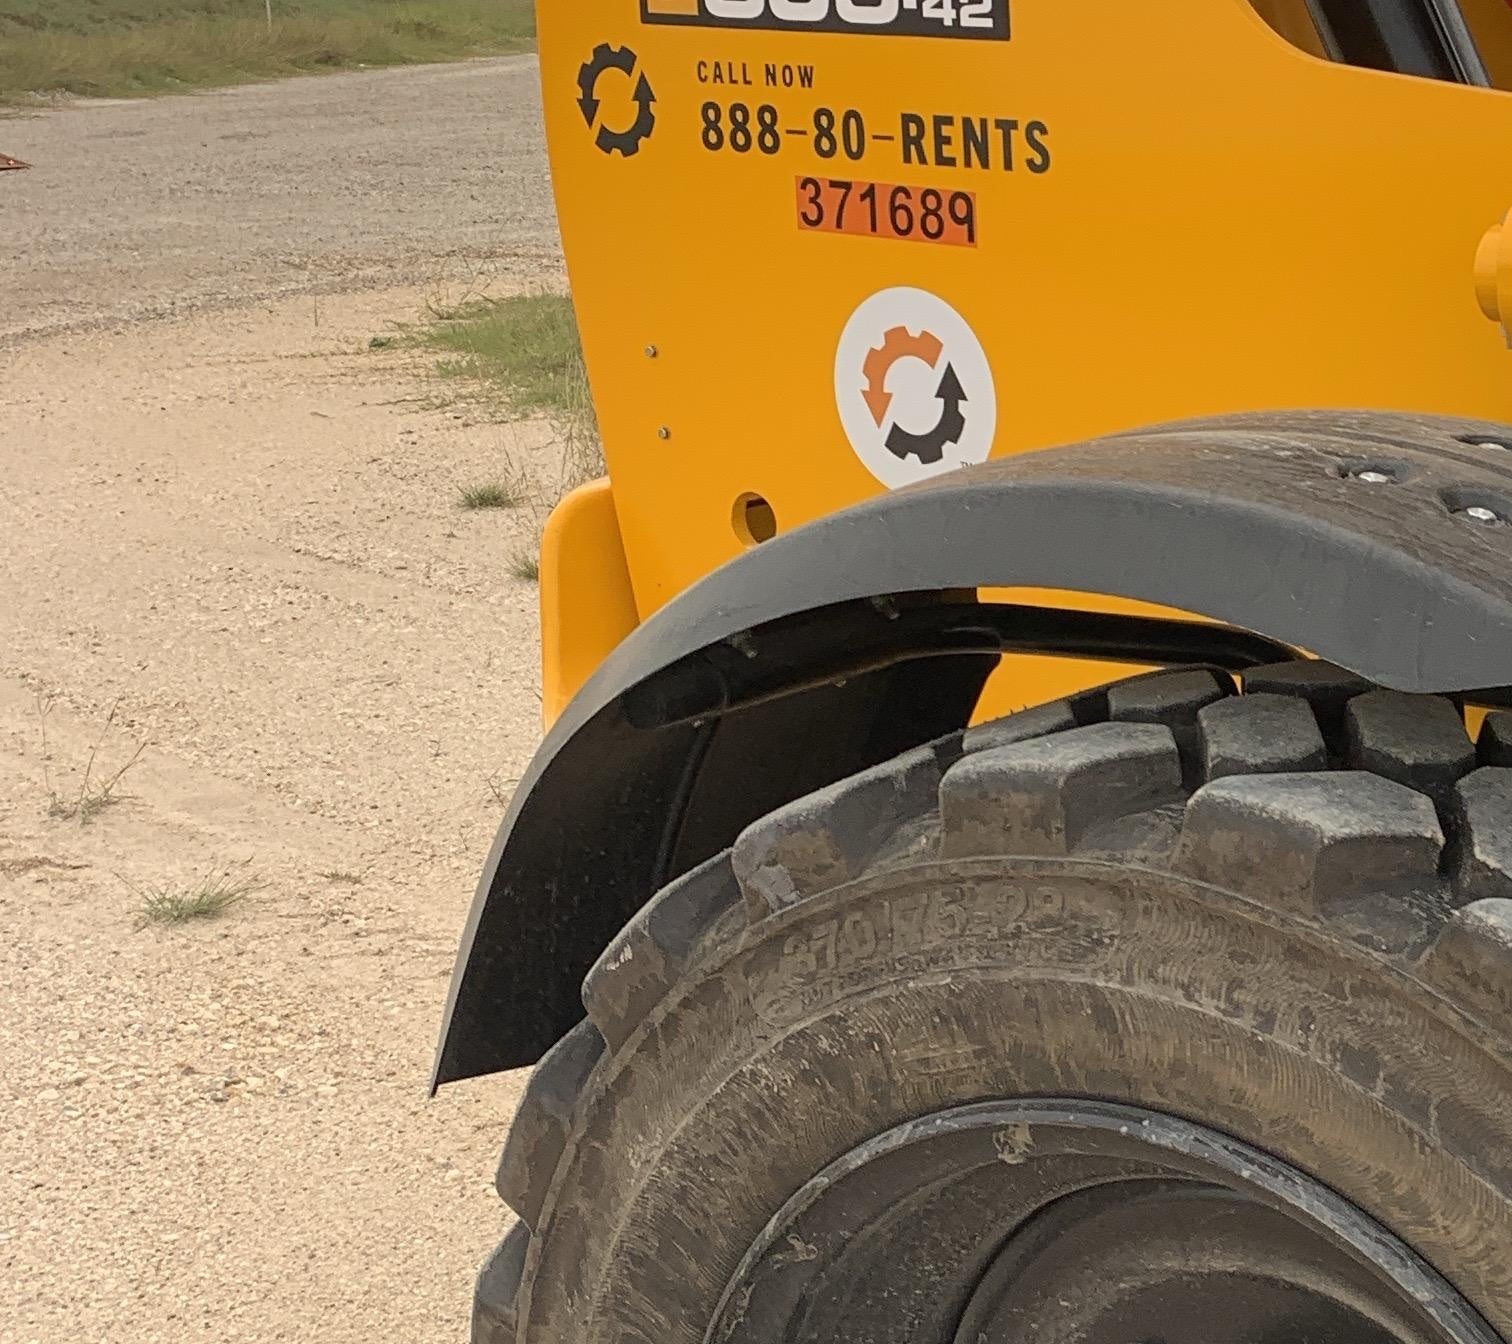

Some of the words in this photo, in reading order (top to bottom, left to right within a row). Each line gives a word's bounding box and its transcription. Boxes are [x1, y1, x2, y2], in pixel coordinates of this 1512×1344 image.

[697, 60, 753, 86] CALL
[764, 63, 814, 88] NOW
[701, 101, 1051, 174] 888-80-RENTS
[799, 176, 976, 244] 371689
